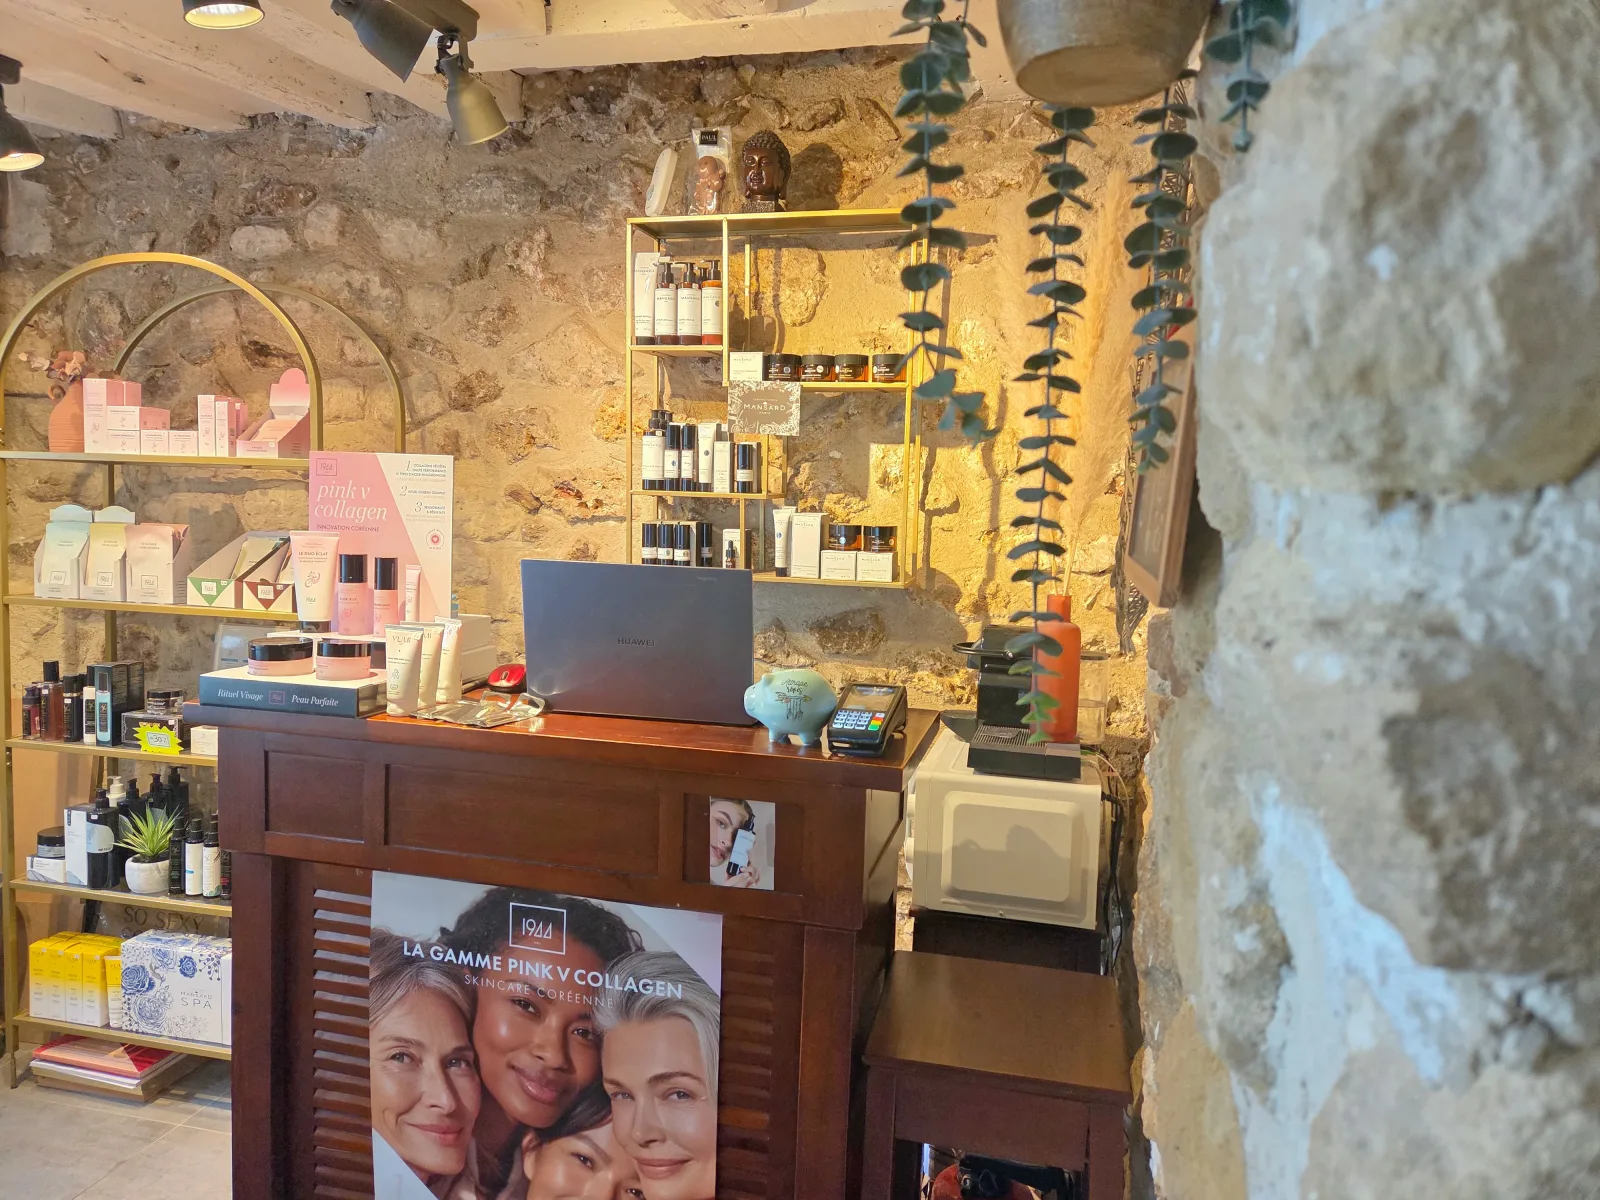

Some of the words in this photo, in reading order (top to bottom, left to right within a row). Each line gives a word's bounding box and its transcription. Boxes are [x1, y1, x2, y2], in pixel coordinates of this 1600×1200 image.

[743, 403, 786, 411] MANSARD
[316, 480, 357, 501] pink
[361, 486, 370, 499] v
[399, 485, 408, 496] 2
[314, 500, 387, 523] collagen
[414, 500, 423, 513] 3
[351, 524, 380, 532] CORÉENNE
[617, 637, 655, 647] HUAWEI
[217, 688, 239, 699] Rituel
[240, 690, 264, 701] Visage
[291, 694, 310, 704] Peau
[310, 696, 339, 707] Parfaite
[123, 905, 148, 926] SO
[522, 917, 553, 940] 1944
[403, 941, 425, 958] LA
[429, 944, 502, 972] GAMME
[508, 957, 554, 981] PINK
[556, 965, 571, 983] V
[574, 968, 683, 999] COLLAGEN
[464, 973, 531, 996] SKINCARE
[536, 986, 615, 1010] CORÉENNE
[180, 996, 213, 1010] SPA
